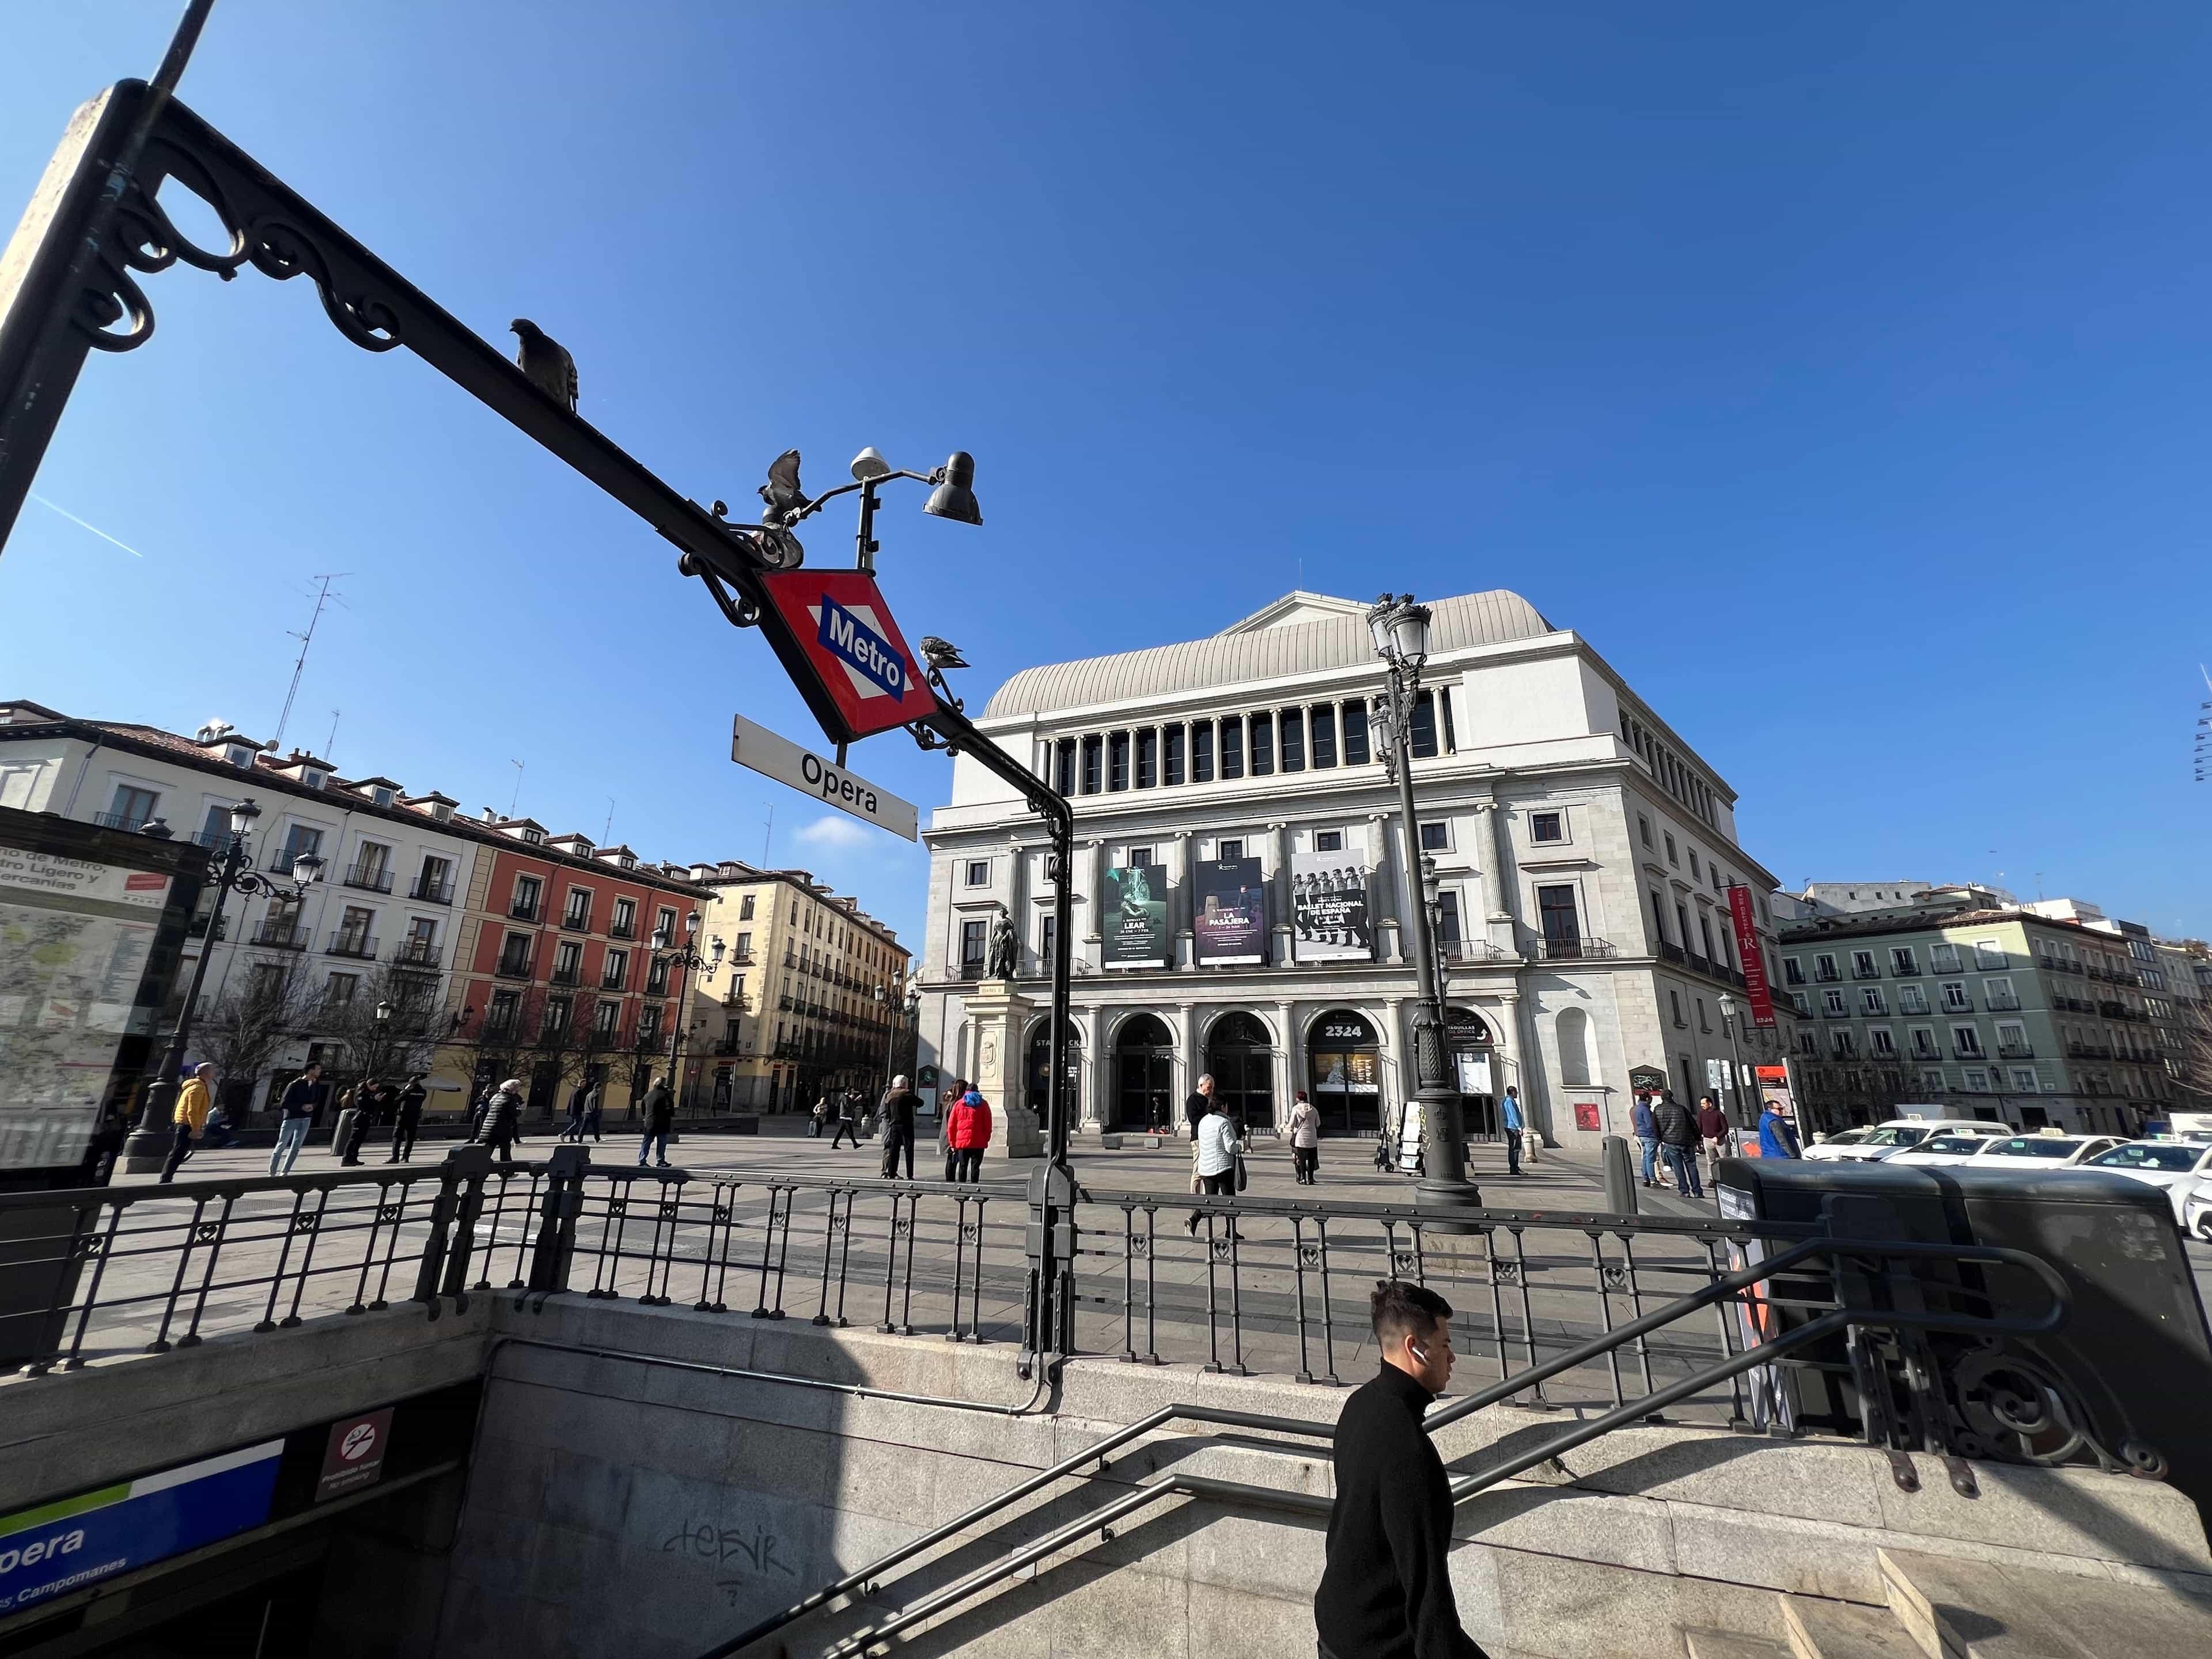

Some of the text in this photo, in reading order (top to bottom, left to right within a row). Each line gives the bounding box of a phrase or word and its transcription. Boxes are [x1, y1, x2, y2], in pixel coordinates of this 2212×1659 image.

[830, 608, 899, 687] Metro
[802, 753, 878, 815] Opera
[26, 851, 47, 862] de
[54, 856, 107, 874] Metro,
[30, 862, 85, 880] Ligero
[88, 874, 100, 884] y
[1325, 900, 1364, 909] NACIONAL
[1124, 922, 1145, 930] LEAR
[1209, 917, 1250, 926] PASAJERA
[17, 1558, 127, 1603] Campomanes
